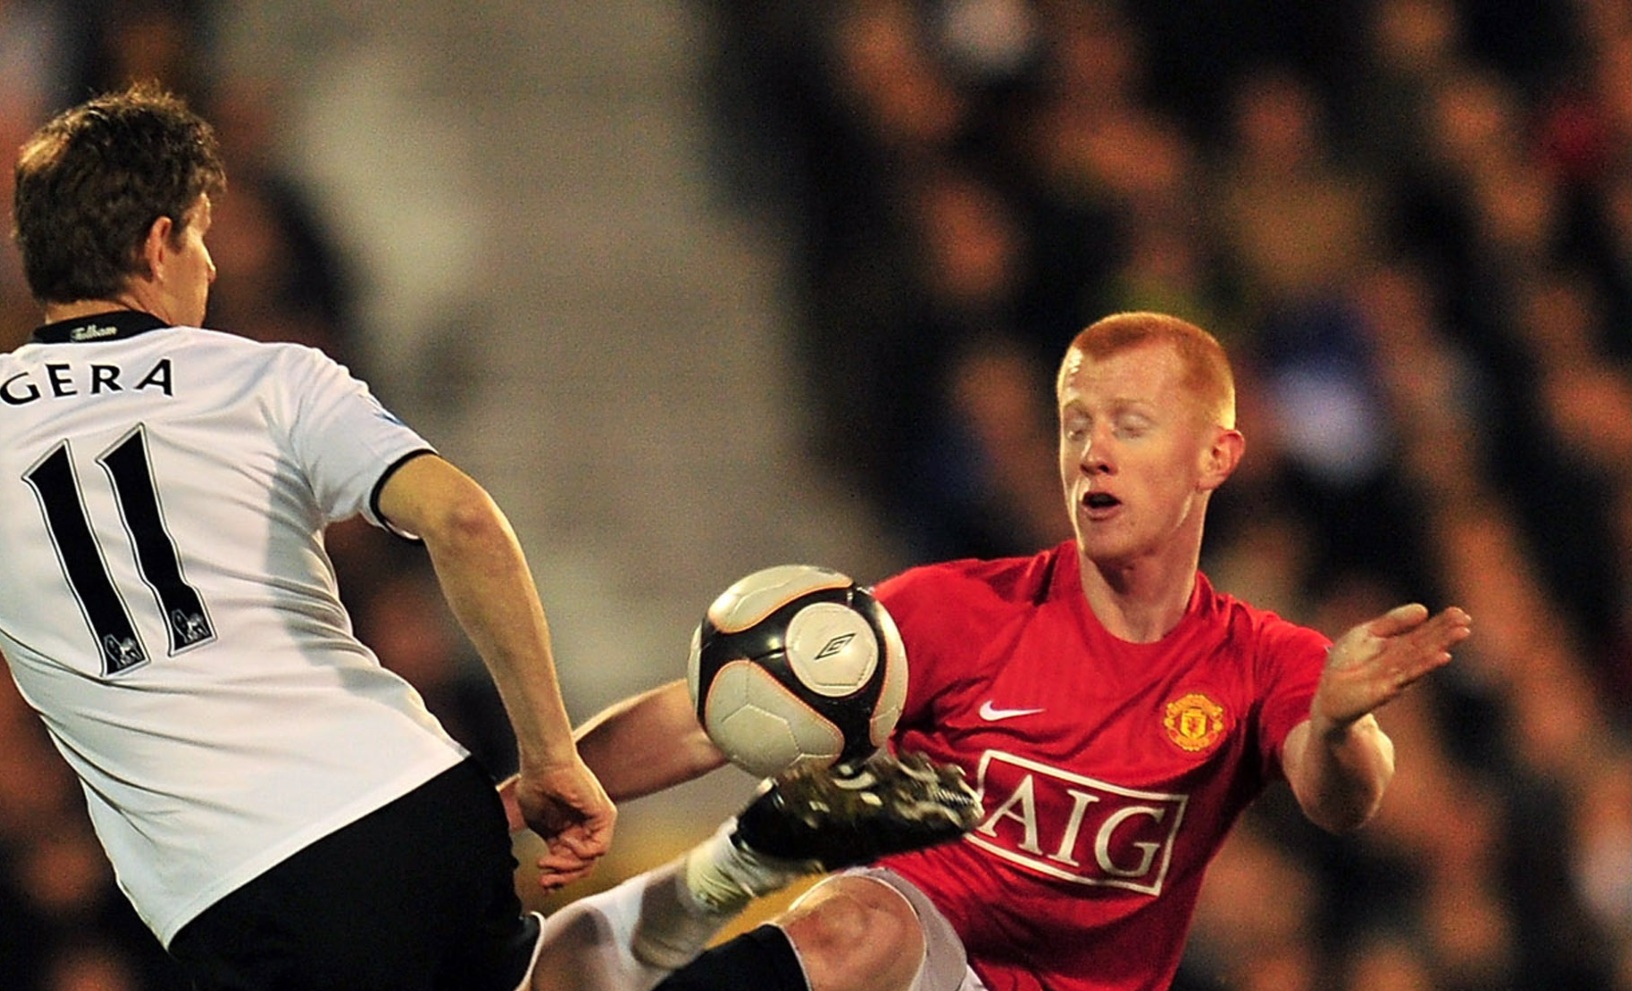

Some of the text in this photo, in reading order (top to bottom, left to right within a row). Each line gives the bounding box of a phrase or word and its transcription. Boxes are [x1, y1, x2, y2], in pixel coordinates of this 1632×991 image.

[0, 358, 174, 405] GERA
[21, 422, 217, 678] 11
[975, 774, 1166, 877] AIG
